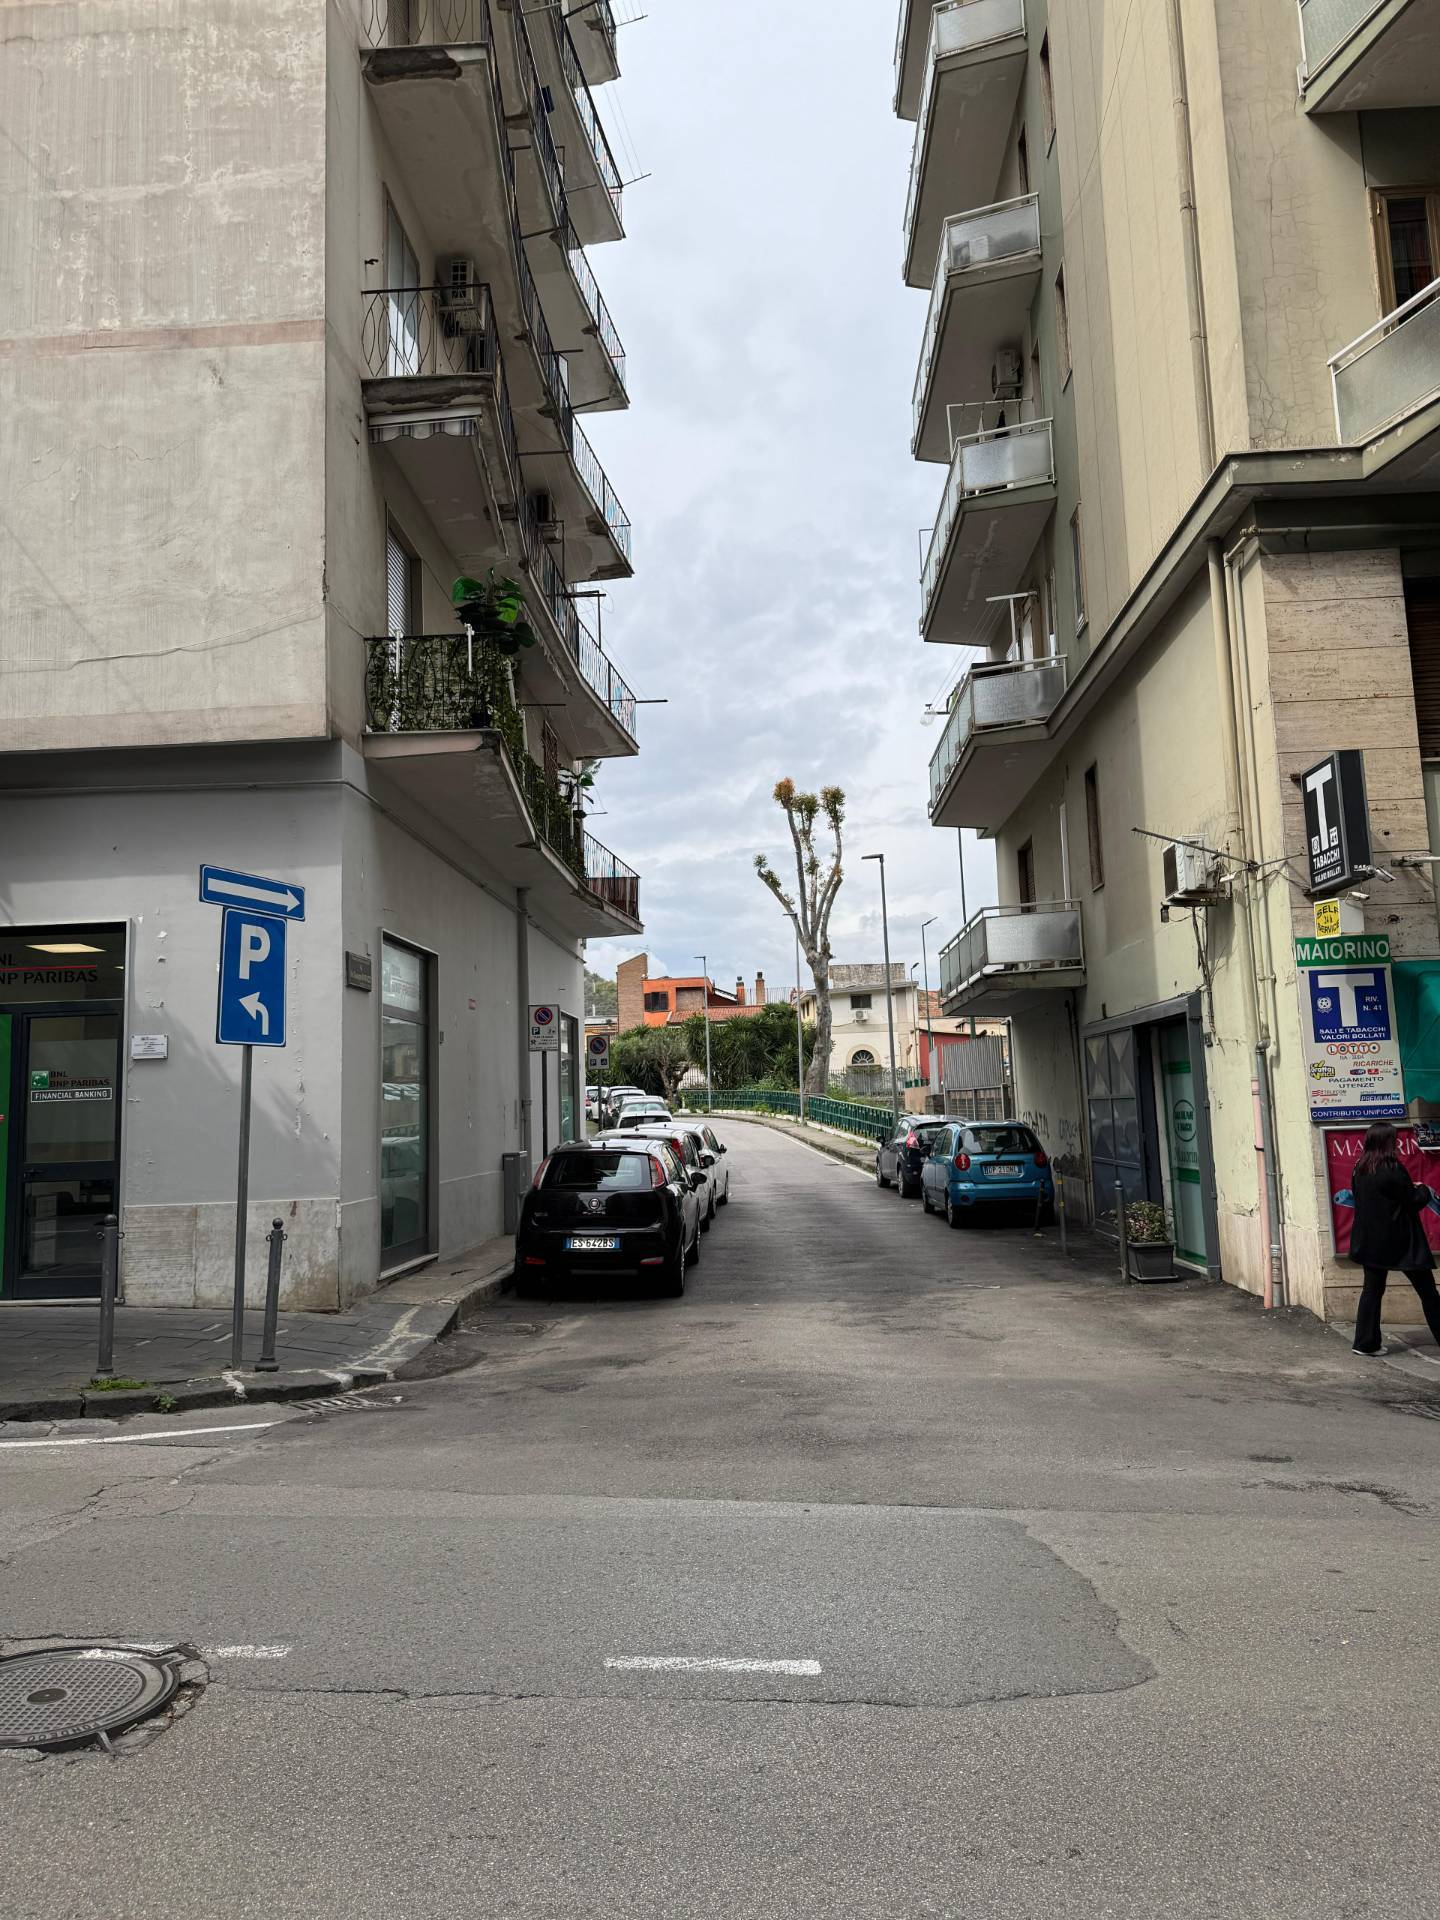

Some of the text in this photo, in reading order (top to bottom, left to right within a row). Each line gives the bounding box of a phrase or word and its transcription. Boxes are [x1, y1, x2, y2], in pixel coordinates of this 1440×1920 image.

[1306, 764, 1332, 852] T
[1313, 847, 1340, 870] TABACCHI
[239, 924, 271, 980] P
[1296, 940, 1390, 961] MAIORINO
[23, 969, 98, 984] PARIBAS
[1318, 973, 1375, 1027] T
[1353, 1059, 1394, 1067] RICARICHE
[71, 1079, 110, 1087] PARIBAS
[35, 1090, 108, 1100] FINANCIAL BANKING
